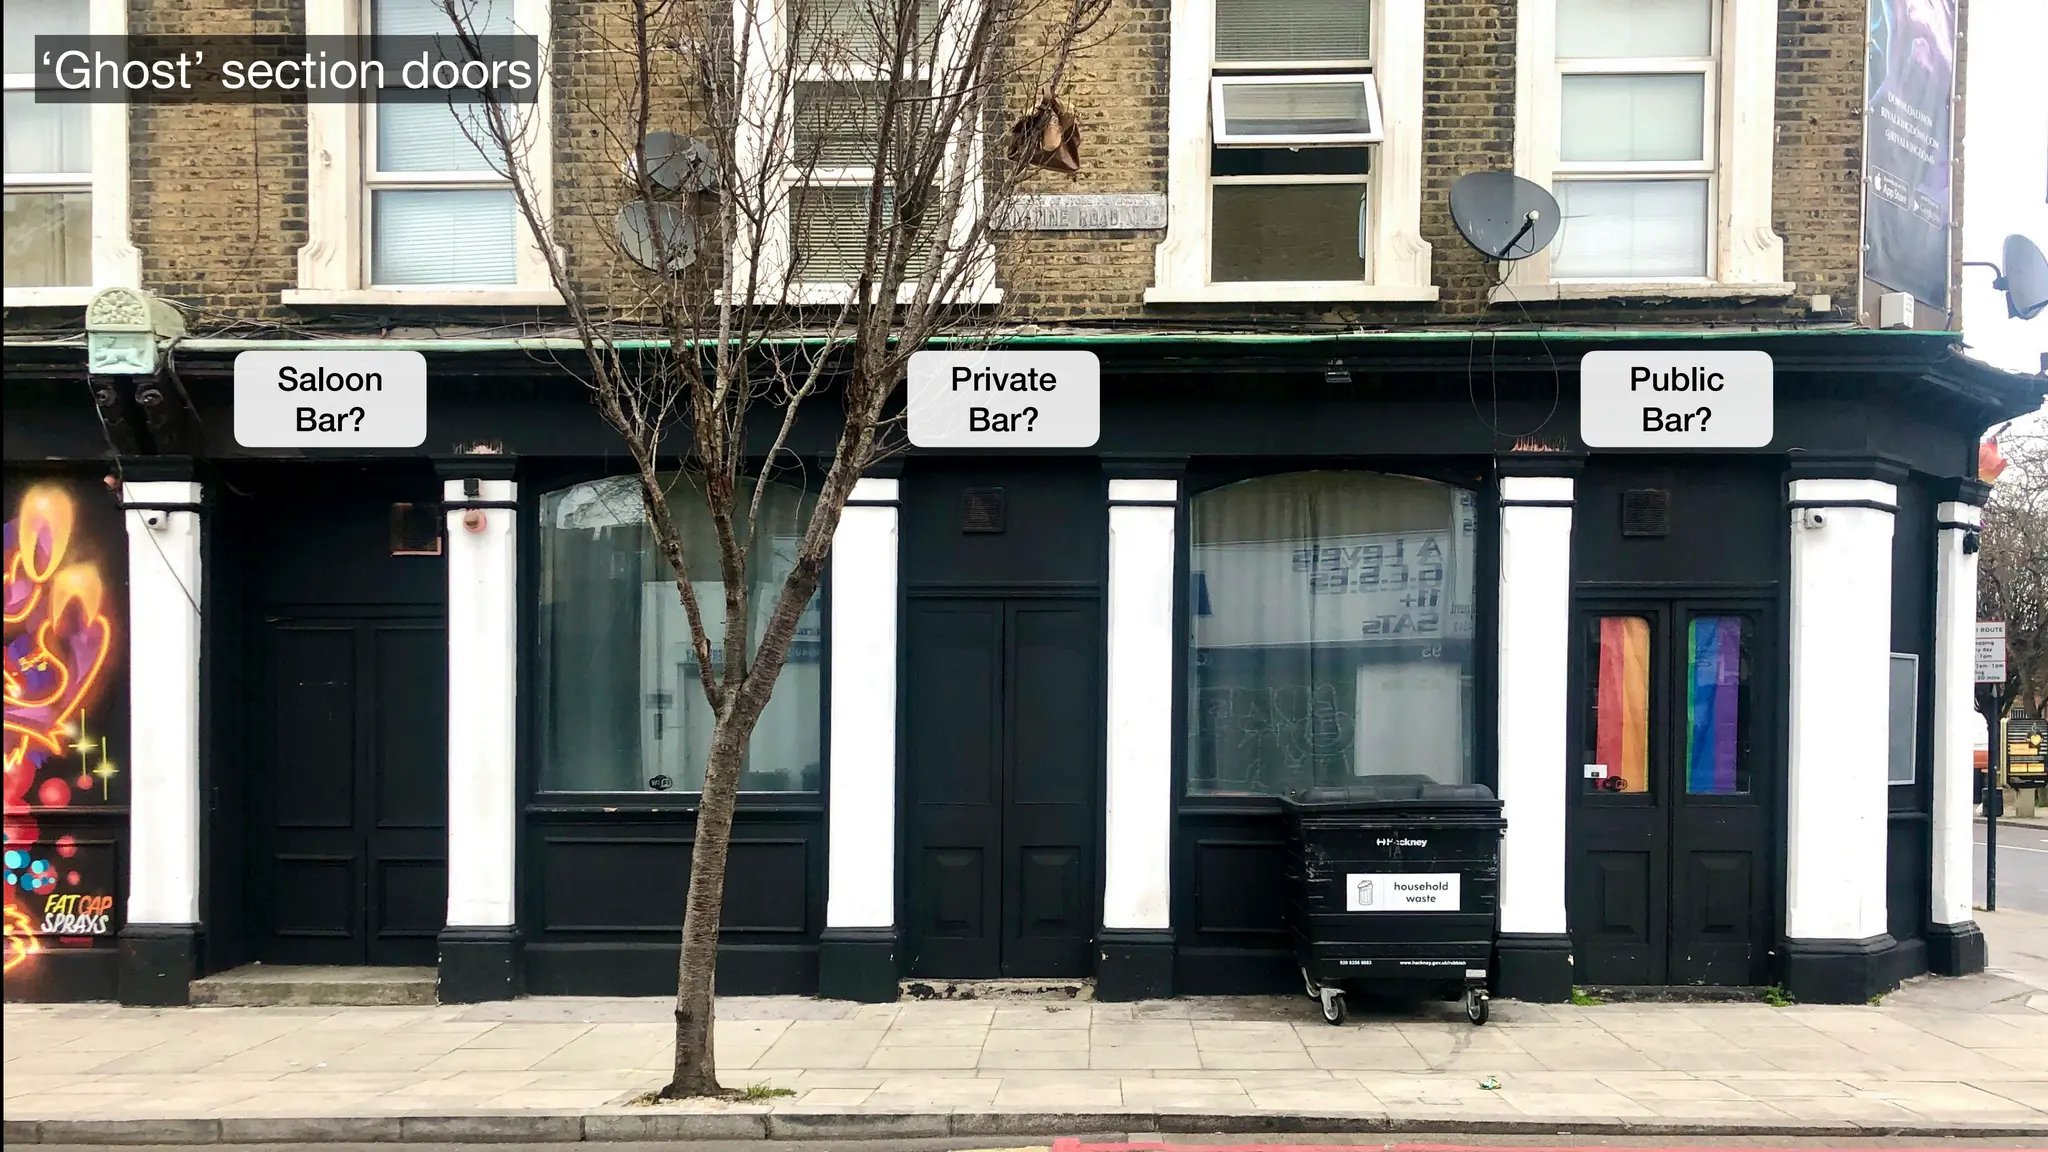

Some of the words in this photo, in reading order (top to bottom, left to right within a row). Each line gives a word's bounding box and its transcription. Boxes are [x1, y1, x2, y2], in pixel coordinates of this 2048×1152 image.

[1394, 881, 1449, 891] household
[1405, 894, 1437, 903] waste
[41, 912, 109, 934] SPRAYS
